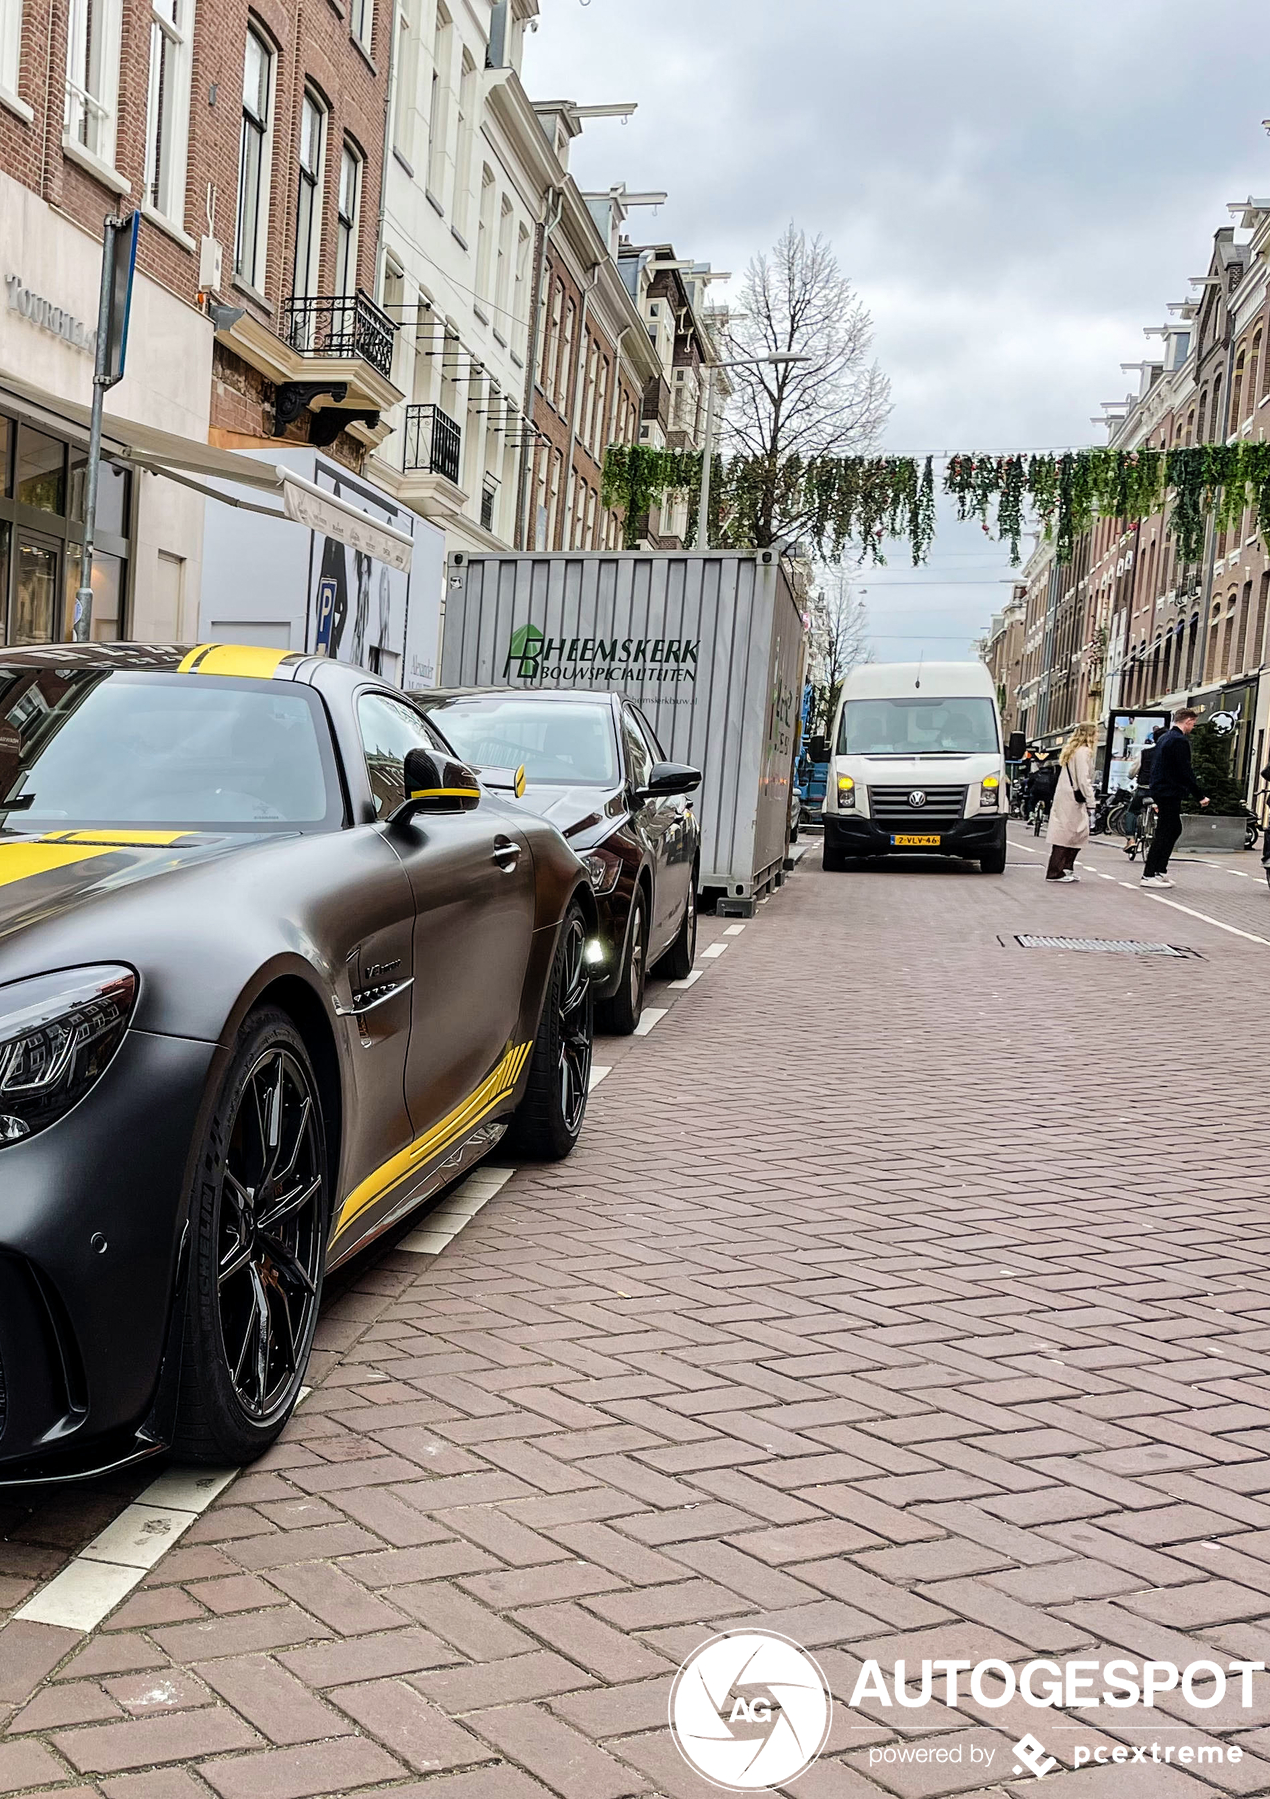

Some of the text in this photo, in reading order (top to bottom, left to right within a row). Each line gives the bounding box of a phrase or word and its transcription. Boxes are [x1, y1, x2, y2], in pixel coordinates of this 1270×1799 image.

[4, 273, 98, 356] TOURBILLO
[320, 587, 332, 632] P
[198, 1182, 216, 1332] MICHELIN
